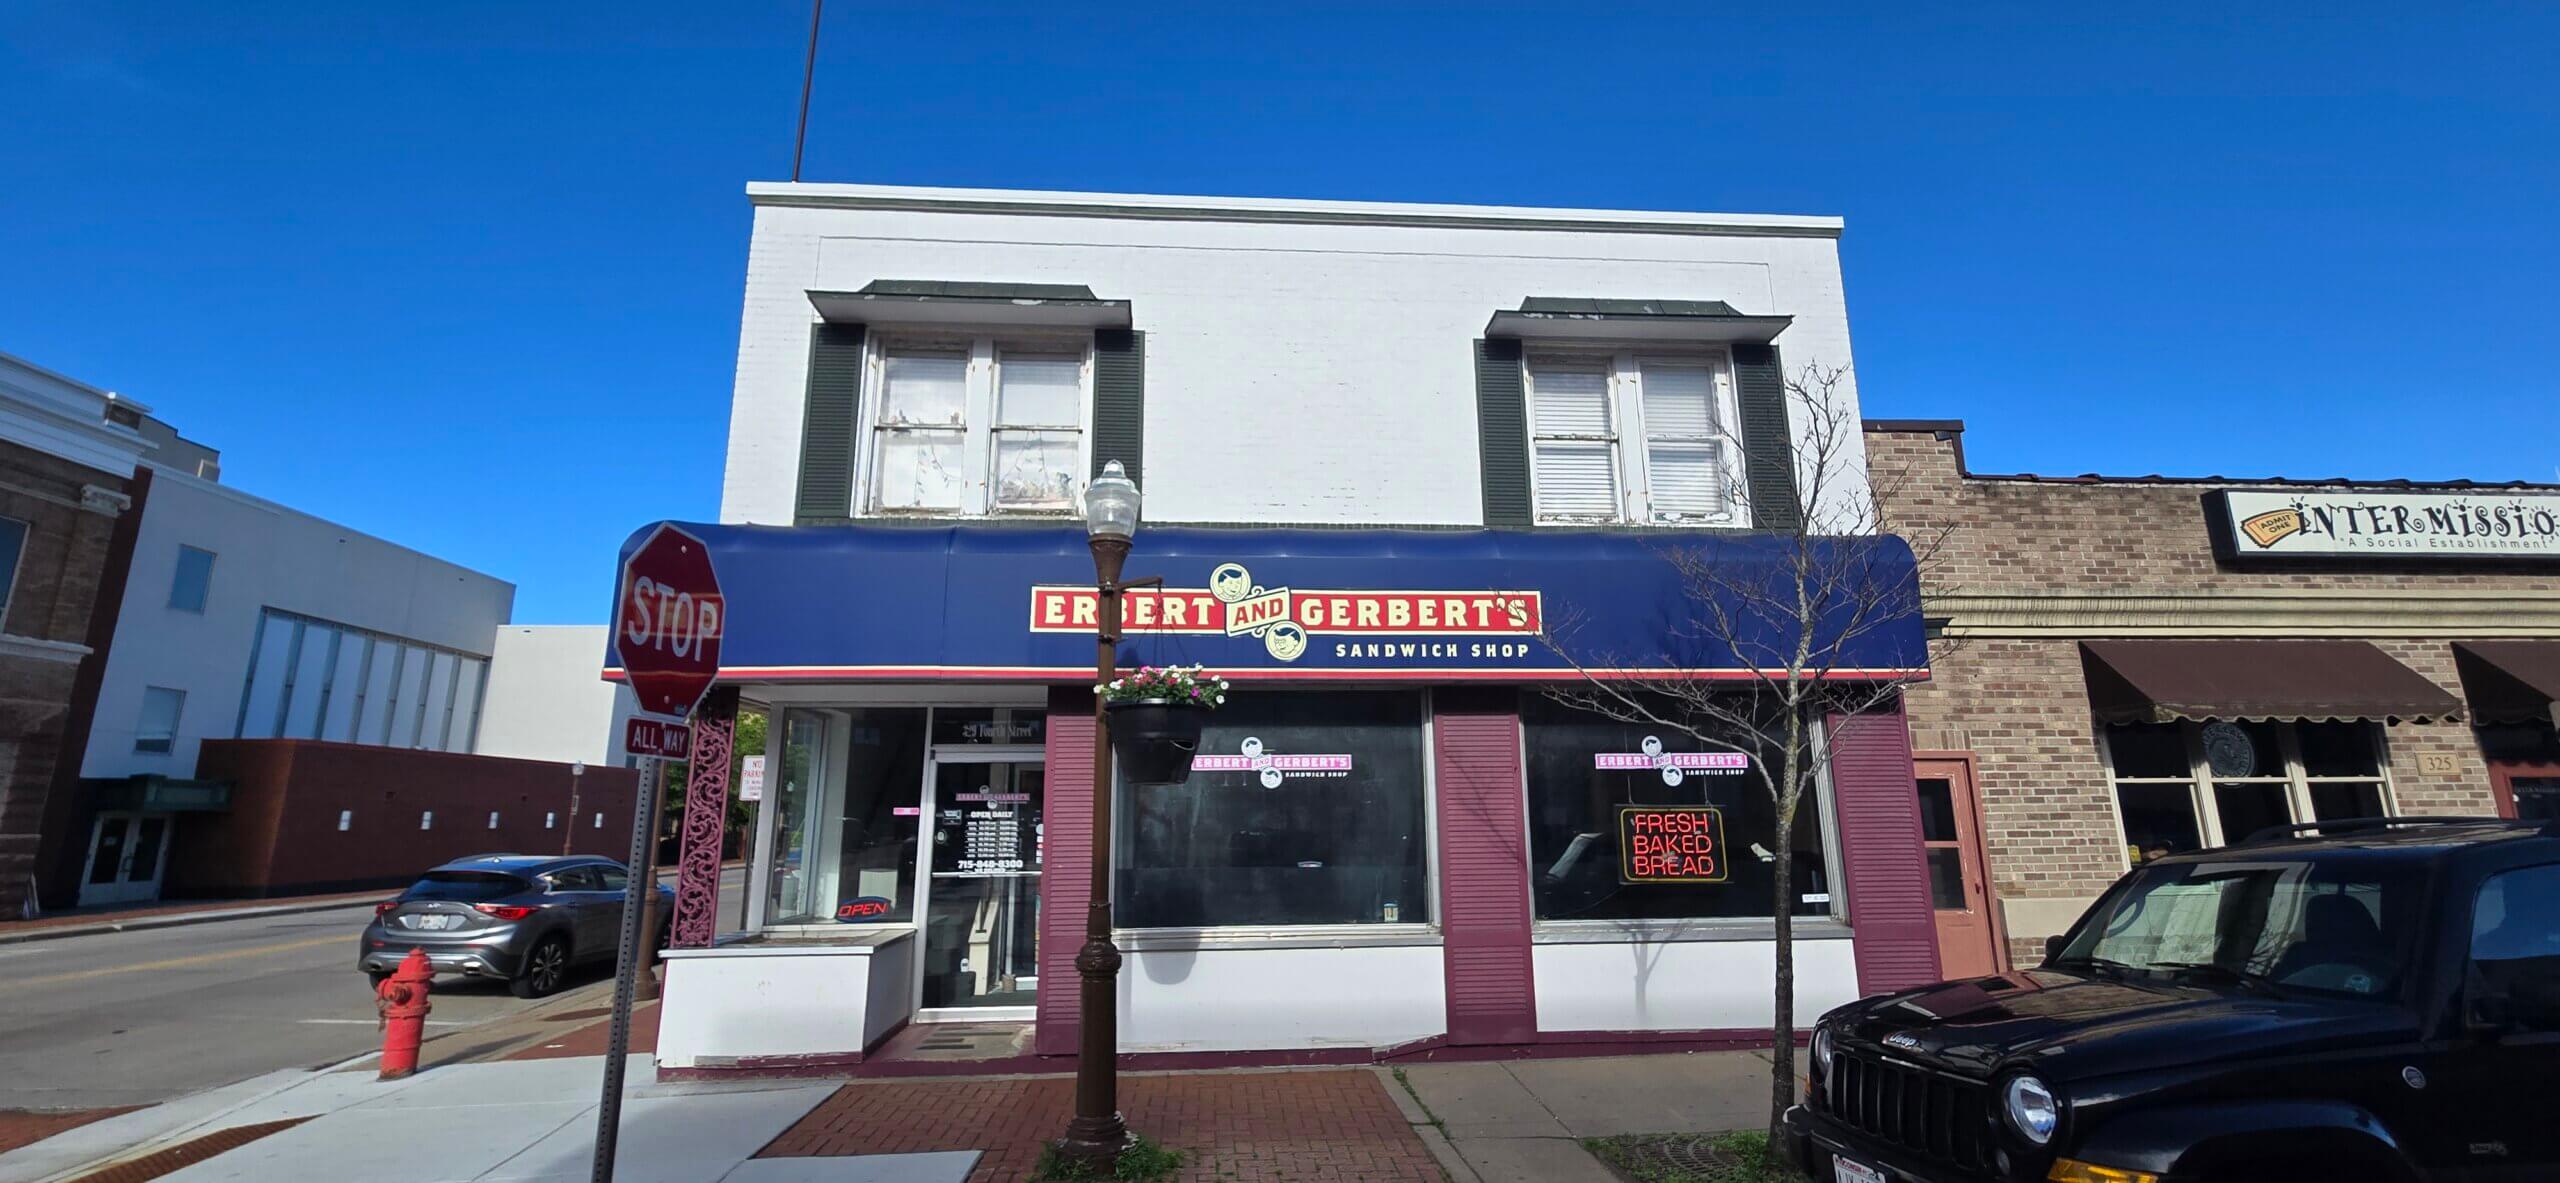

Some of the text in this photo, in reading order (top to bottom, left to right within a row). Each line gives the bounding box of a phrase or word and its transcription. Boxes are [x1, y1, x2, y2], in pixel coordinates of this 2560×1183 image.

[2260, 514, 2291, 529] ADMIT
[2268, 523, 2291, 533] ONE
[2367, 537, 2418, 547] Social
[628, 576, 718, 662] STOP
[1233, 597, 1283, 627] AND
[1300, 597, 1528, 627] GERBERT'S
[1336, 643, 1529, 658] SANDWICH SHOP
[632, 725, 687, 753] ALL WAY
[1195, 757, 1249, 768] ERBERT
[1275, 757, 1348, 768] GERBERT'S
[1599, 756, 1650, 766] ERBERT
[1674, 755, 1744, 766] GERBERT'S
[2428, 757, 2452, 771] 325
[1634, 813, 1709, 833] FRESH
[1634, 834, 1712, 854] BAKED
[1634, 856, 1714, 875] BREAD
[837, 902, 888, 917] OPEN
